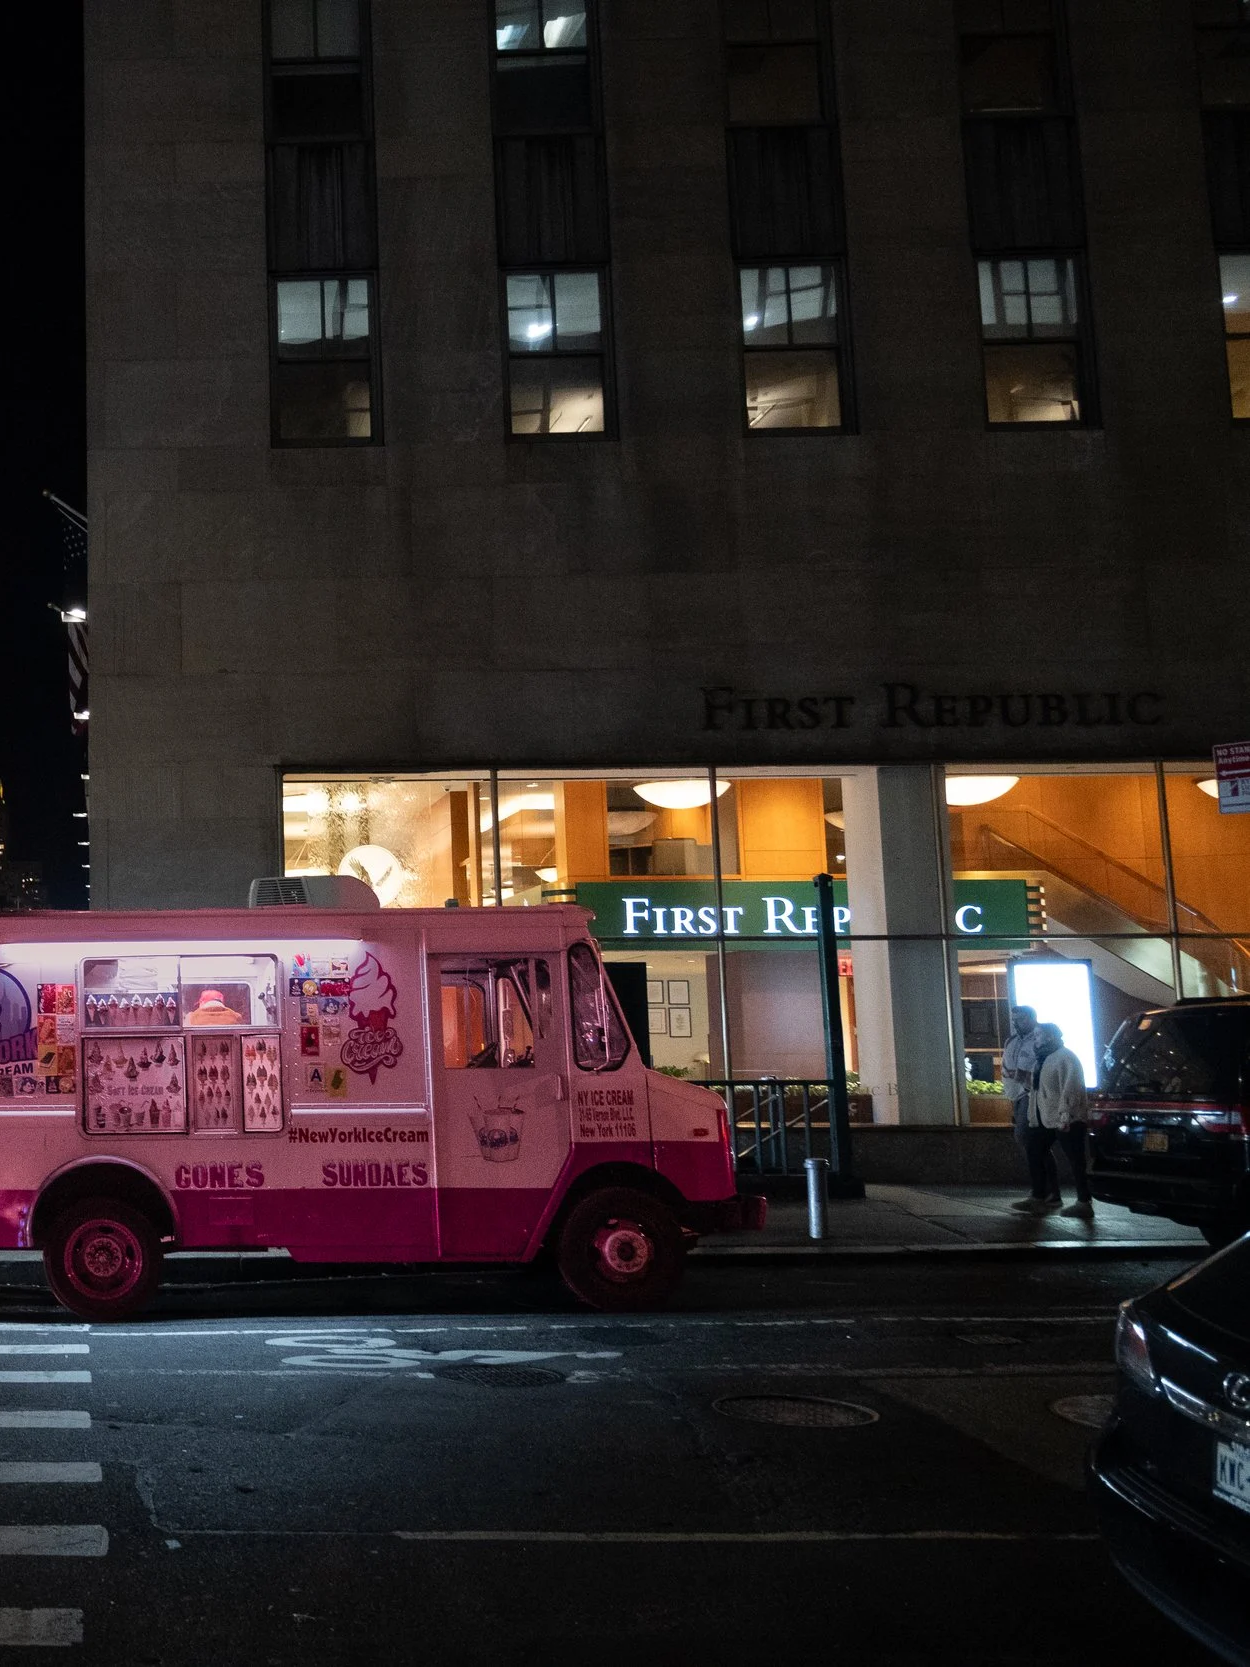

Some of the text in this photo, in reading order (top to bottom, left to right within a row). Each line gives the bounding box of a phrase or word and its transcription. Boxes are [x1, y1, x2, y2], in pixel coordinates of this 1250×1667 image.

[1216, 748, 1228, 757] NO
[621, 897, 743, 935] FIRST
[310, 1068, 323, 1082] A
[578, 1089, 635, 1106] NY ICE CREAM
[288, 1128, 429, 1143] #NewYorkIceCream
[579, 1123, 596, 1138] New
[596, 1123, 614, 1138] York
[175, 1159, 429, 1188] CONES SUNDAES
